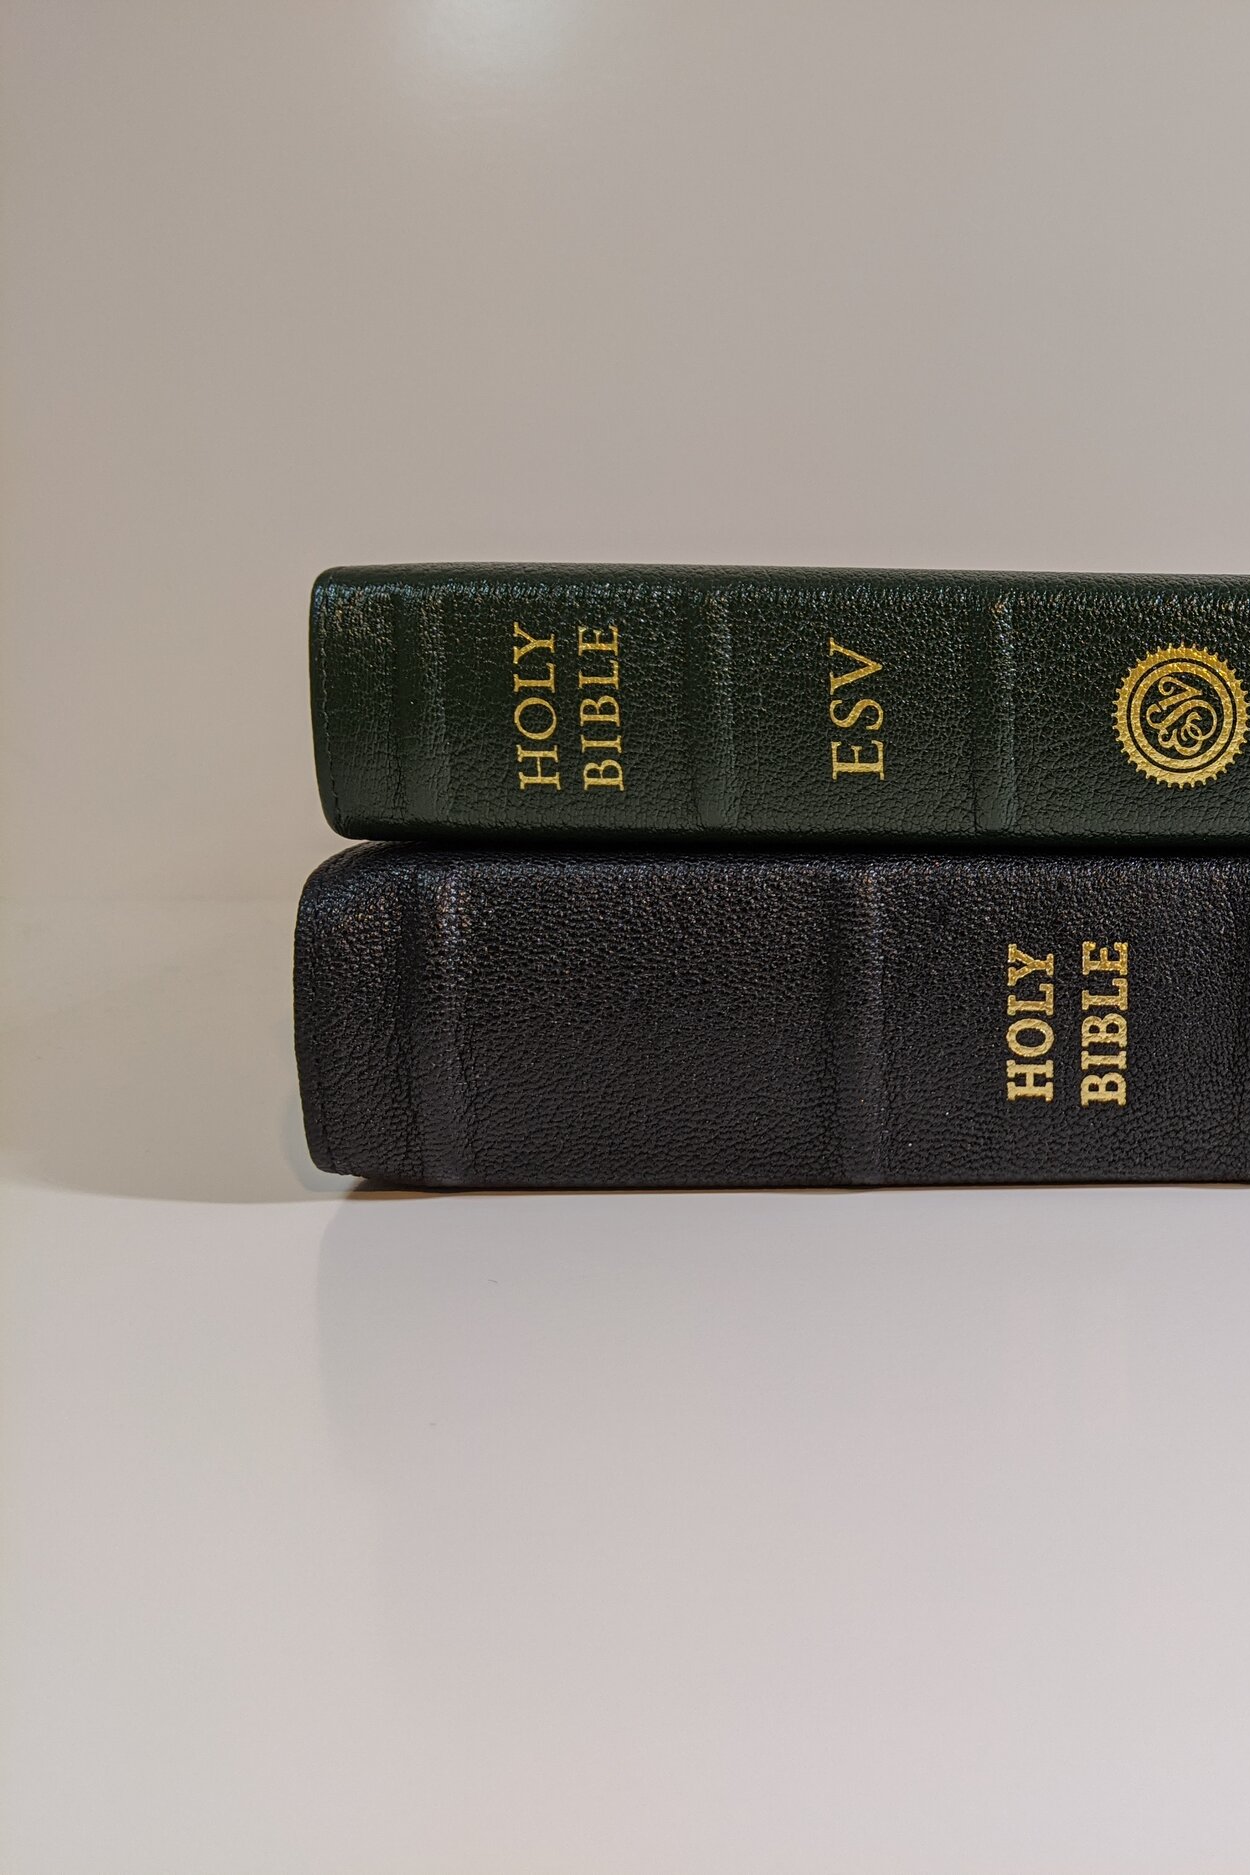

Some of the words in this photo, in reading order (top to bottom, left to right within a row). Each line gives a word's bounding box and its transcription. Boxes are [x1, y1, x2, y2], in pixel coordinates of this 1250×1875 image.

[512, 622, 561, 790] HOLY
[577, 625, 625, 791] BIBLE
[829, 638, 885, 780] ESV
[1005, 943, 1055, 1102] HOLY
[1080, 940, 1129, 1106] BIBLE
